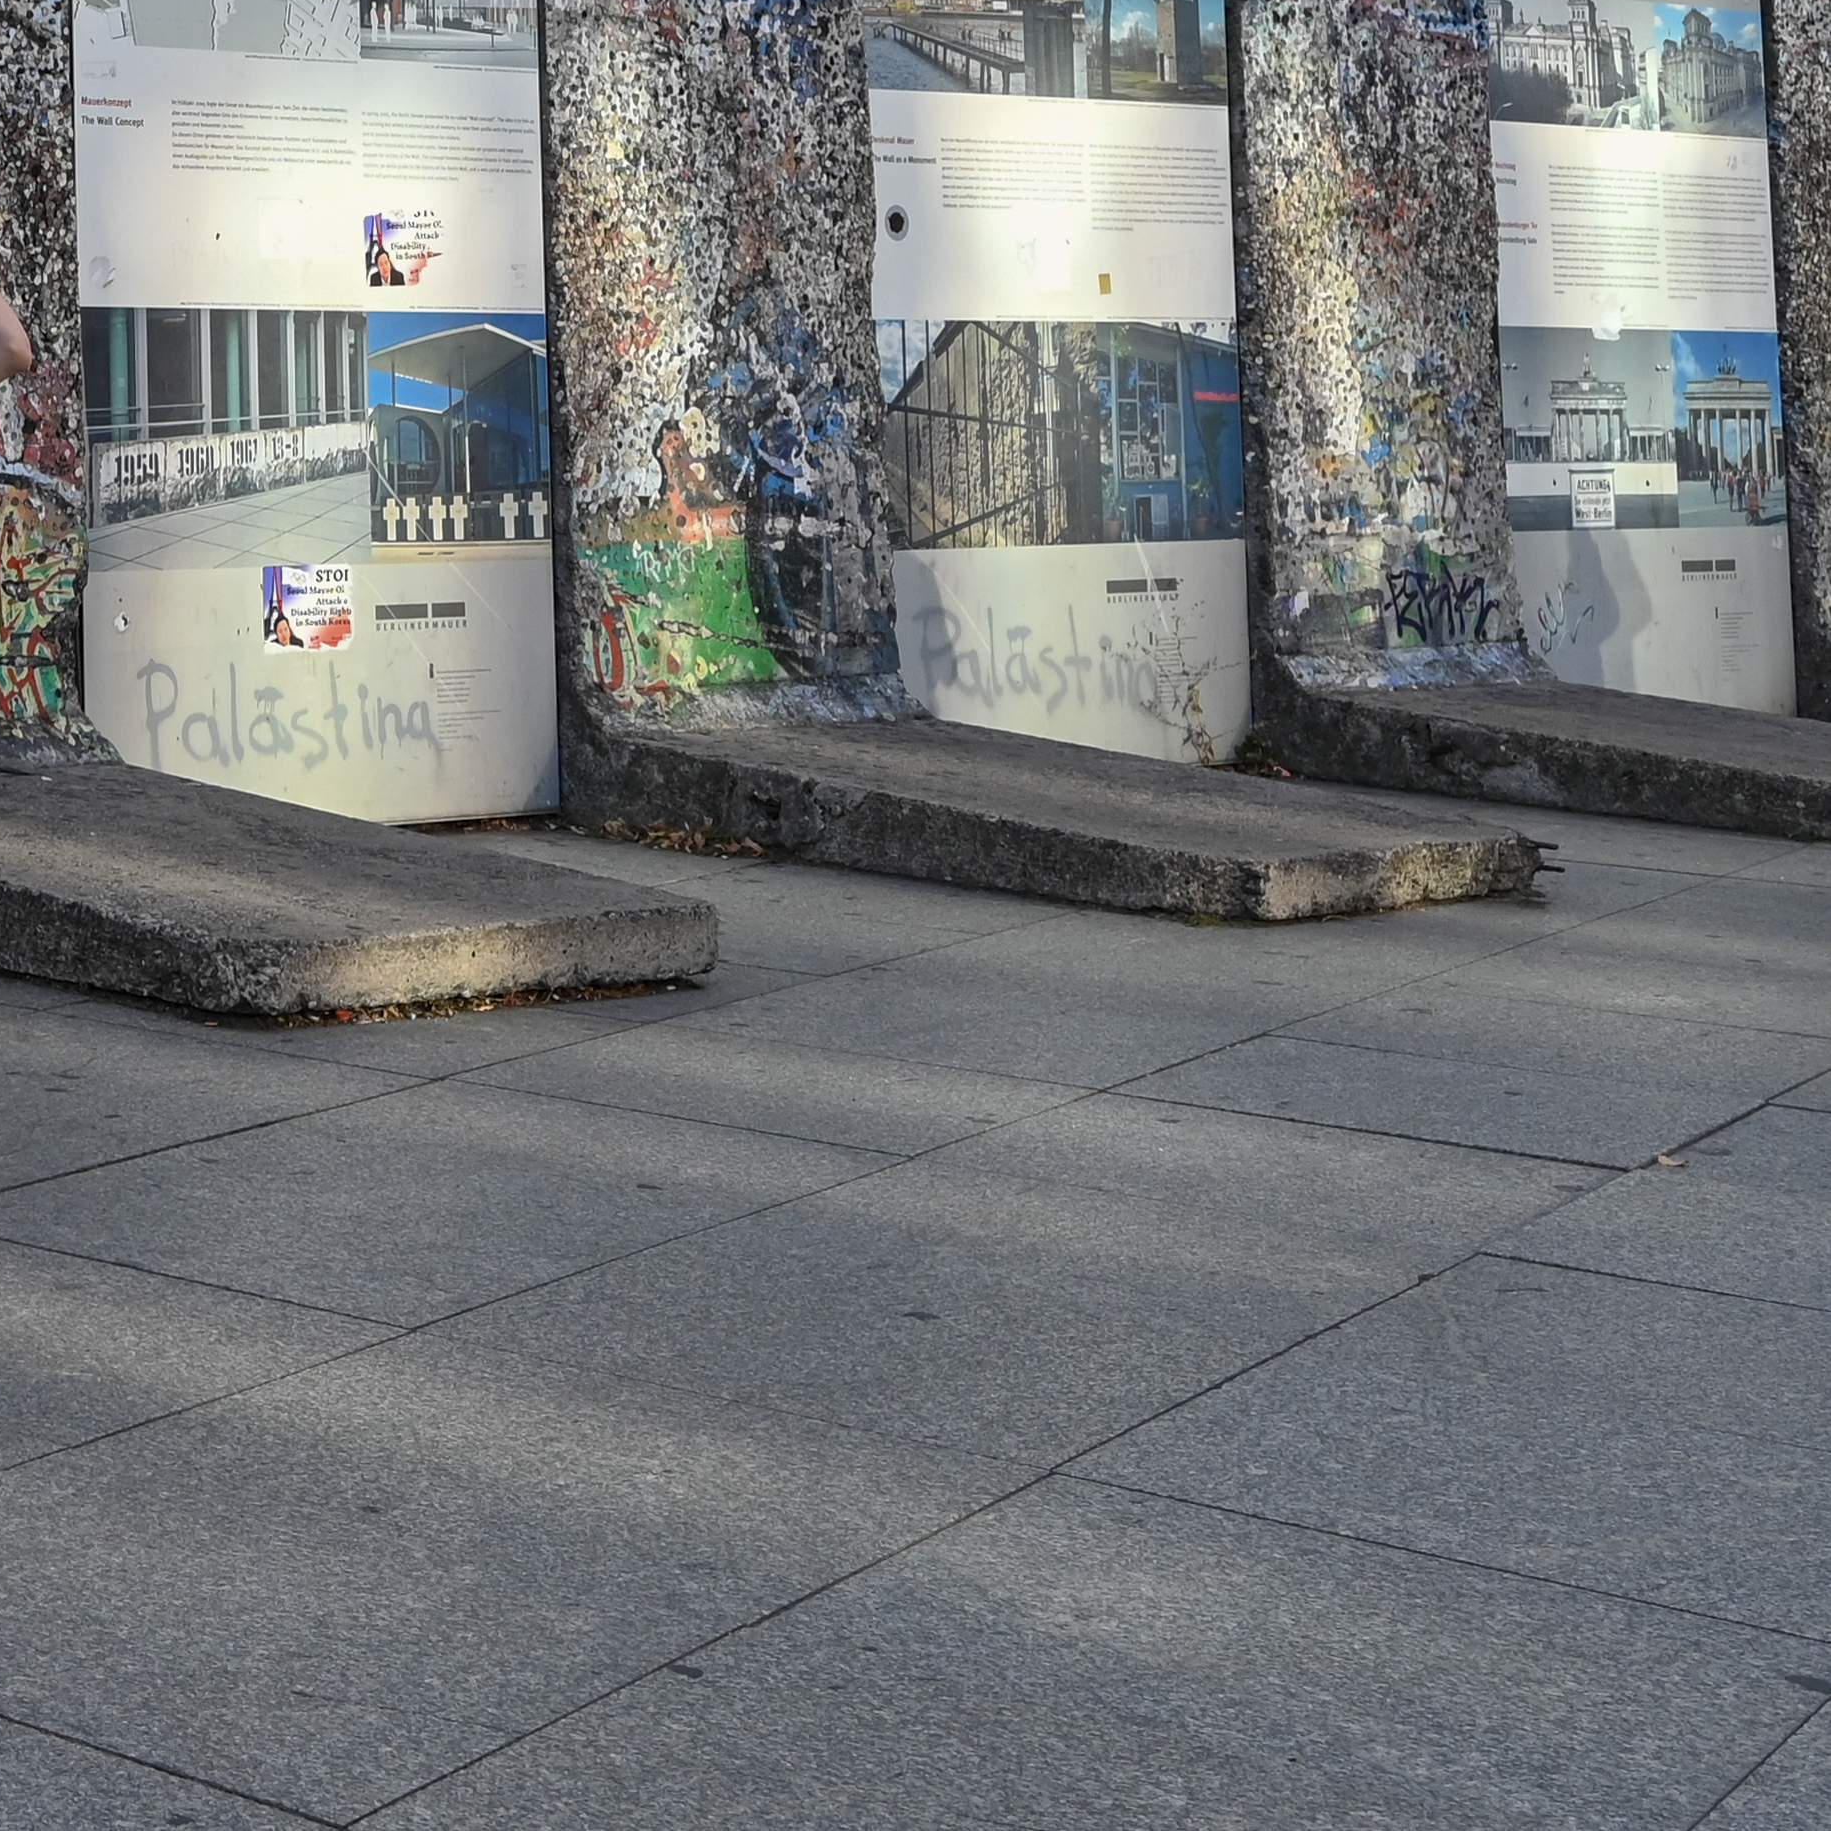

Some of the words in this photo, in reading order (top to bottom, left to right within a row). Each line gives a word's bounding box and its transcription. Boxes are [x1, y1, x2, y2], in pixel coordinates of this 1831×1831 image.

[81, 96, 131, 107] Mauerkonzept
[81, 115, 94, 124] The
[96, 116, 113, 125] Wall
[115, 117, 143, 128] Concept
[229, 438, 258, 466] 1961
[177, 445, 214, 478] 1960
[114, 452, 159, 485] 1959
[315, 569, 349, 583] STO
[290, 607, 327, 618] Disability
[304, 617, 326, 626] South
[375, 620, 467, 632] BERLINERMAUER
[137, 658, 441, 772] Palästina
